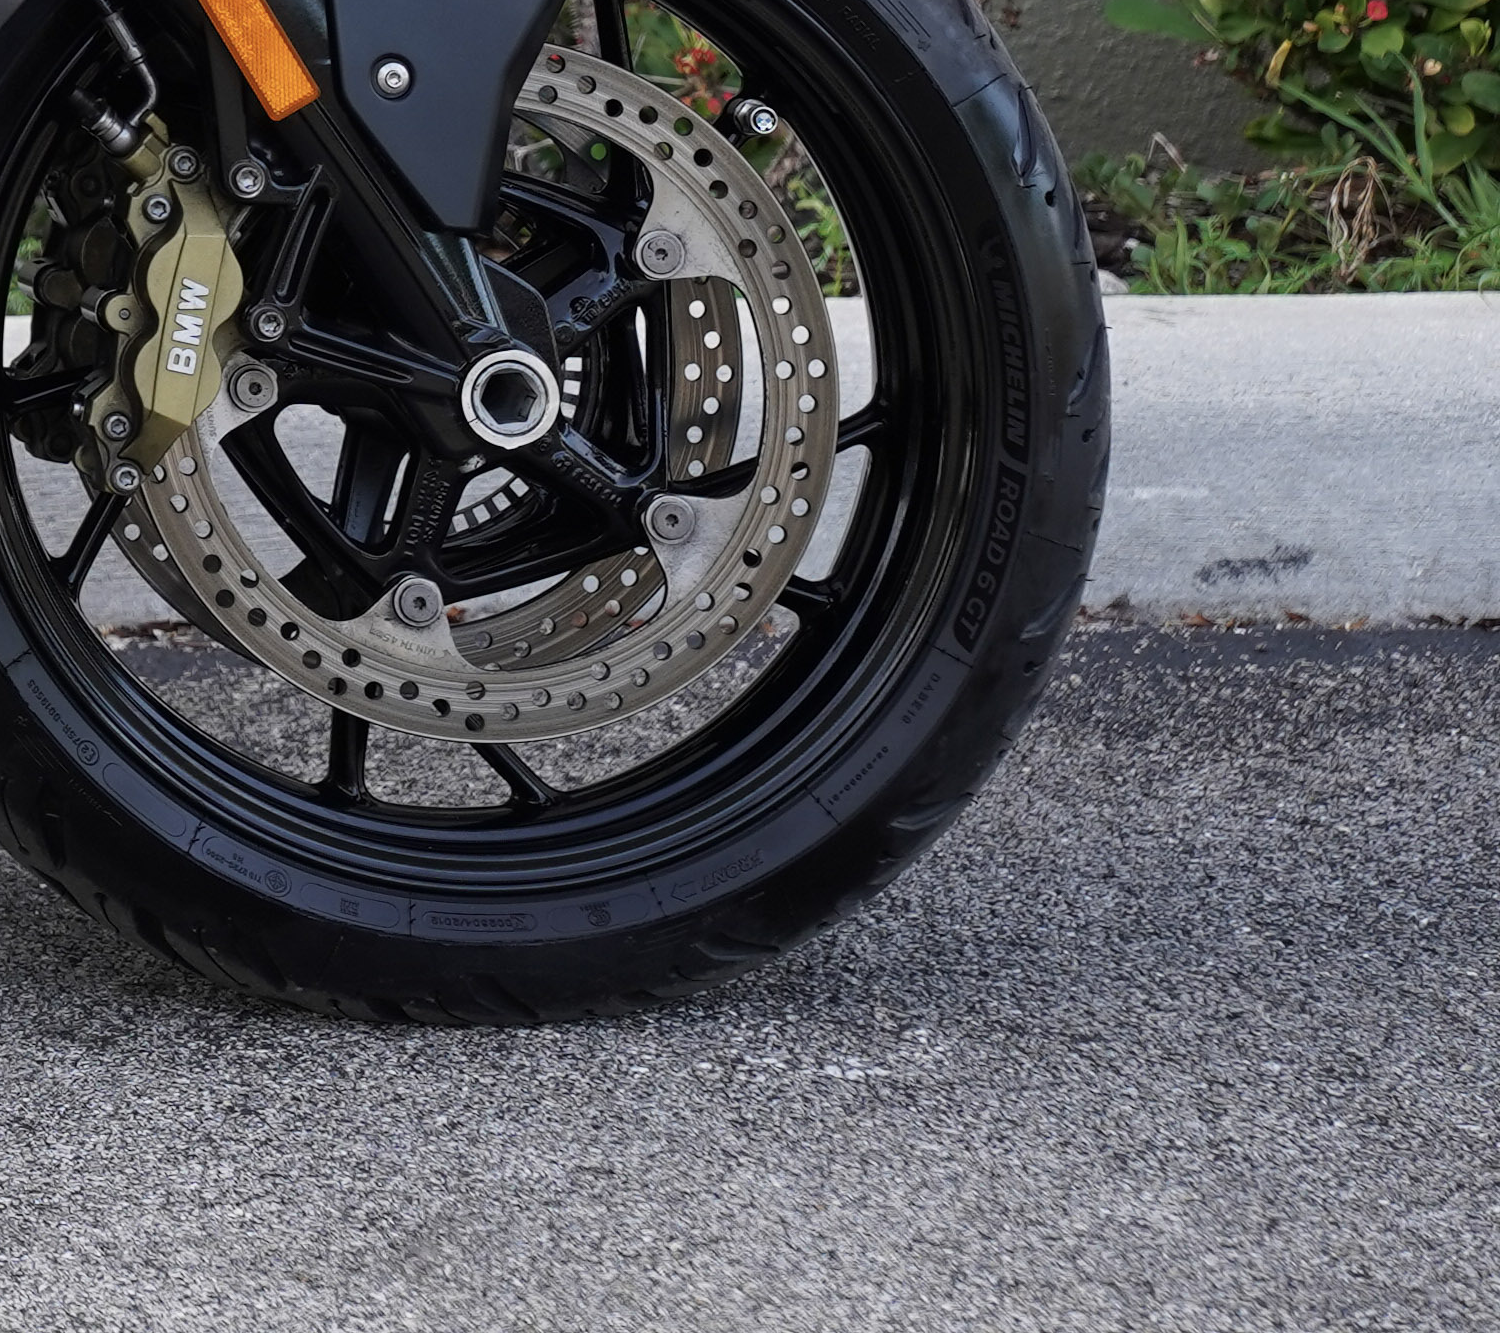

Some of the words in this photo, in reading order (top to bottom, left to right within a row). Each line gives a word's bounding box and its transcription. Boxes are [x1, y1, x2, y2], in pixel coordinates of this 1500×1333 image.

[166, 278, 210, 375] BMW
[993, 281, 1024, 447] MICHELIN
[988, 479, 1021, 563] ROAD
[977, 575, 997, 593] 6
[959, 596, 987, 640] GT
[700, 848, 765, 892] FRONT
